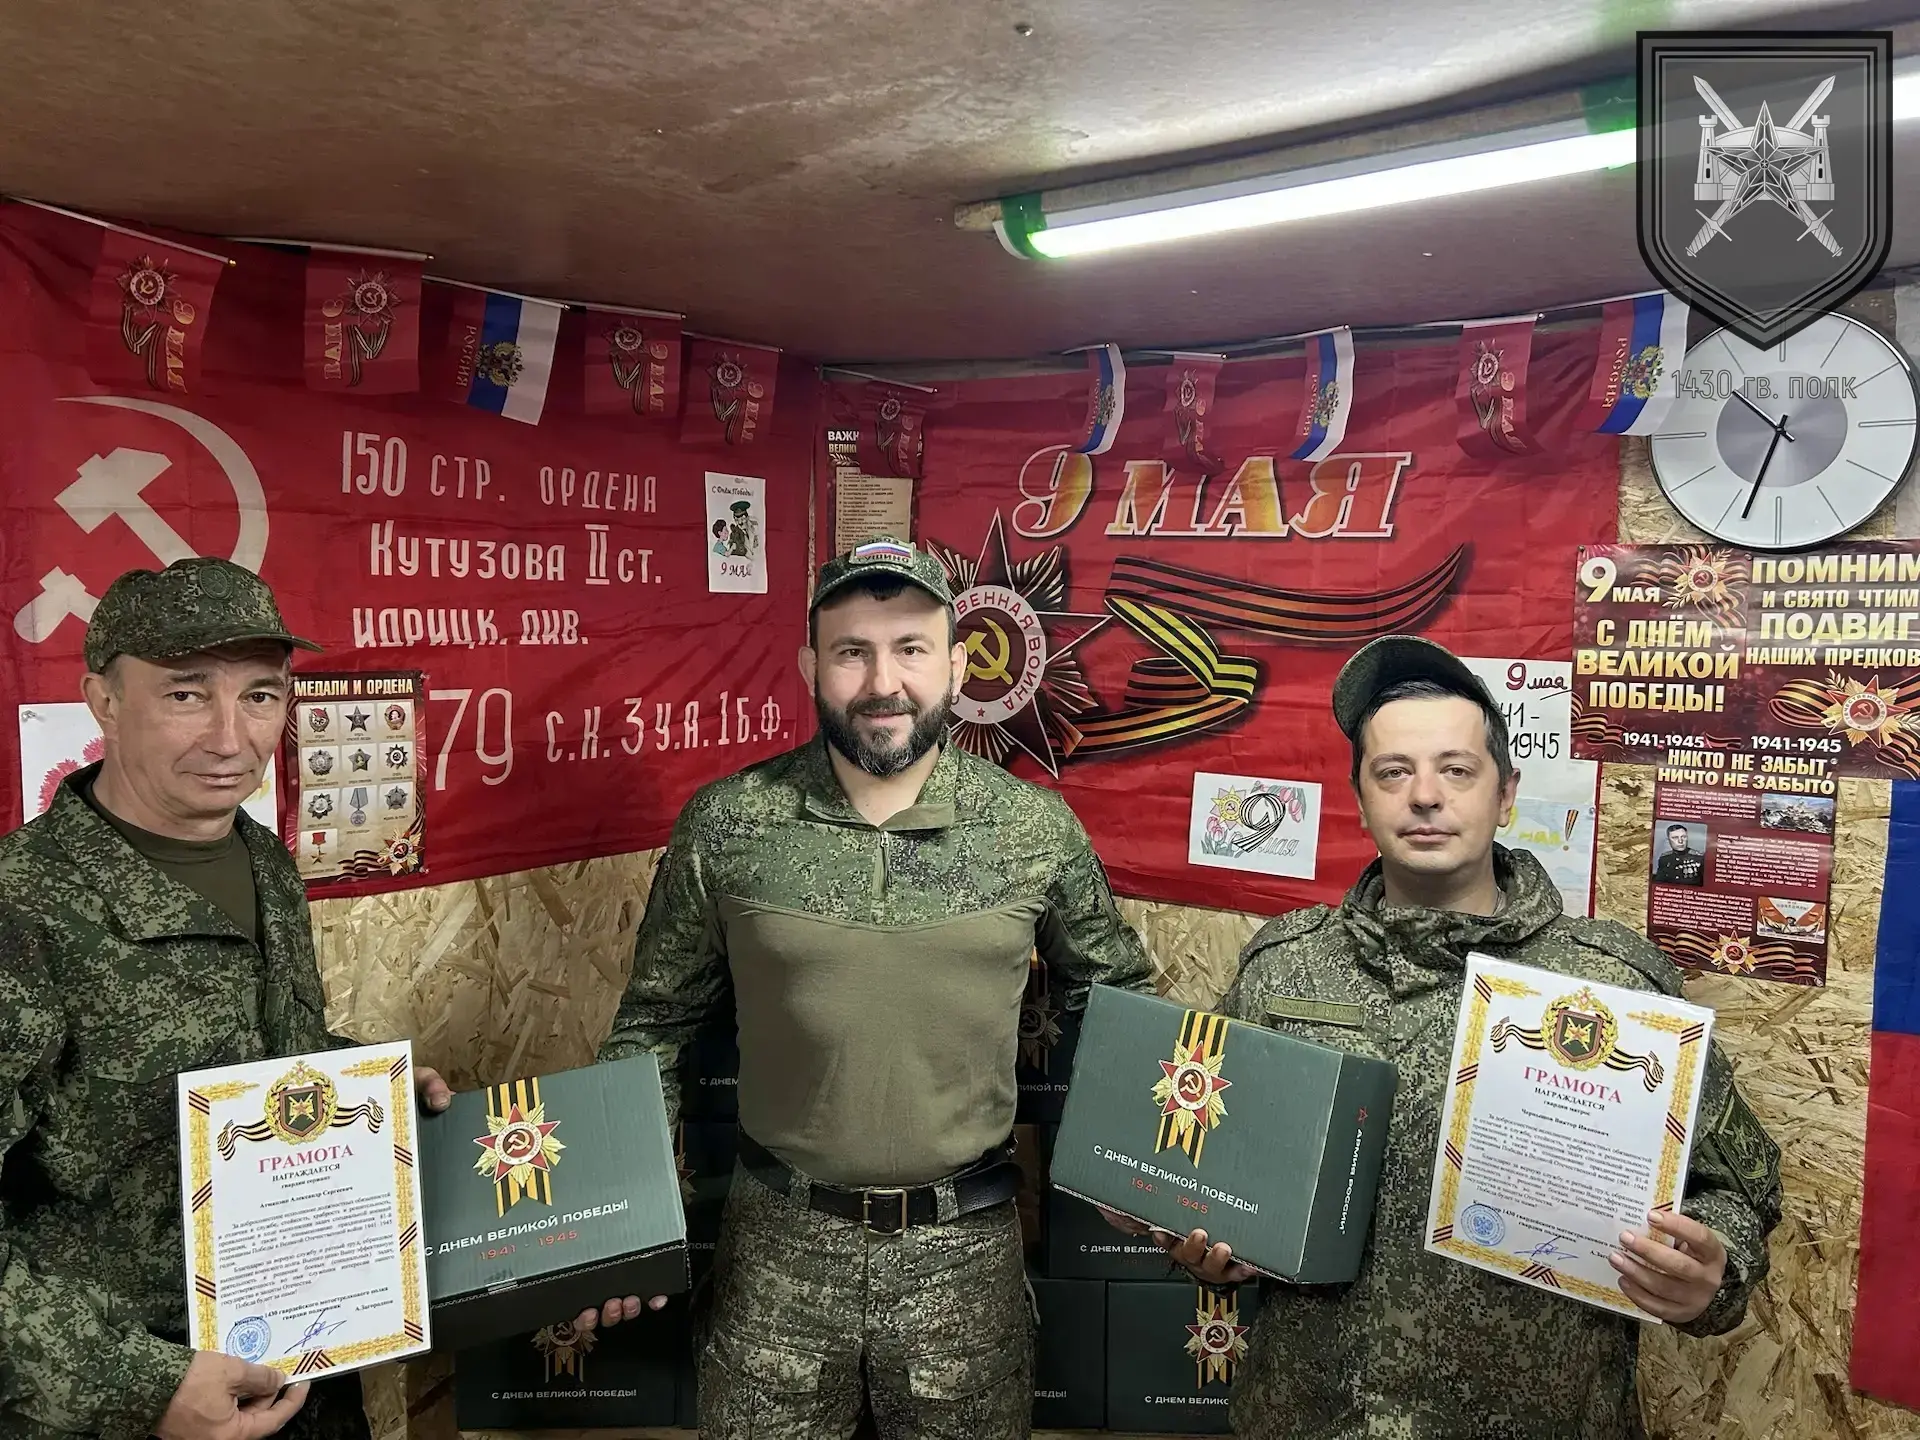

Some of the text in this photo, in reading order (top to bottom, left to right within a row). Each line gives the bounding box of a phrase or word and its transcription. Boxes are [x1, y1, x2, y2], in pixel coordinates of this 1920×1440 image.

[455, 324, 477, 387] РОССИЯ
[1602, 337, 1628, 408] РОССИЯ
[1302, 373, 1318, 436] РОССИЯ
[828, 443, 857, 453] ВЕЛИК
[341, 431, 657, 512] 150 СТР. ОРДЕНА
[1011, 444, 1093, 538] 9
[1104, 452, 1412, 539] МАЯ
[1580, 557, 1660, 603] 9 МАЯ
[1752, 554, 1920, 584] ПОМНИМ
[1762, 588, 1919, 608] И СВЯТО ЧТИМ
[352, 608, 589, 649] ИДРИЦК. ДИВ.
[1596, 615, 1712, 649] С ДНЁМ
[1759, 612, 1920, 645] ПОДВИГ
[1576, 643, 1740, 679] ВЕЛИКОЙ
[1745, 648, 1920, 668] НАШИХ ПРЕДКОВ
[294, 678, 413, 697] МЕДАЛИ И ОРДЕНА
[1506, 662, 1568, 691] 9 мая
[1589, 681, 1725, 712] ПОБЕДЫ!
[429, 688, 513, 790] 79
[621, 697, 644, 755] 3
[1509, 732, 1560, 759] 1945
[1622, 732, 1705, 748] 1941-1945
[1750, 736, 1842, 753] 1941-1945
[1667, 749, 1834, 779] НИКТО НЕ ЗАБЫТ,
[1657, 766, 1836, 795] НИЧТО НЕ ЗАБЫТО
[700, 1077, 707, 1085] С
[1523, 1065, 1623, 1103] ГРАМОТА
[1534, 1087, 1604, 1111] НАГРАЖДАЕТСЯ
[258, 1143, 353, 1173] ГРАМОТА
[1350, 1128, 1364, 1179] АРМИЯ
[272, 1163, 340, 1182] НАГРАЖДАЕТСЯ
[1093, 1145, 1259, 1215] С ДНЕМ ВЕЛИКОЙ ПОБЕДЫ!
[1175, 1193, 1209, 1215] 1945
[425, 1198, 629, 1256] С ДНЕМ ВЕЛИКОЙ ПОБЕДЫ!
[538, 1230, 578, 1247] 1945
[1080, 1244, 1169, 1254] С ДНЕМ ВЕЛИКО
[491, 1388, 637, 1400] С ДНЕМ ВЕЛИКОЙ ПОБЕДЫ!
[1034, 1390, 1067, 1399] БЕДЫ!
[1144, 1396, 1152, 1404] С
[1155, 1396, 1186, 1406] ДНЕМ
